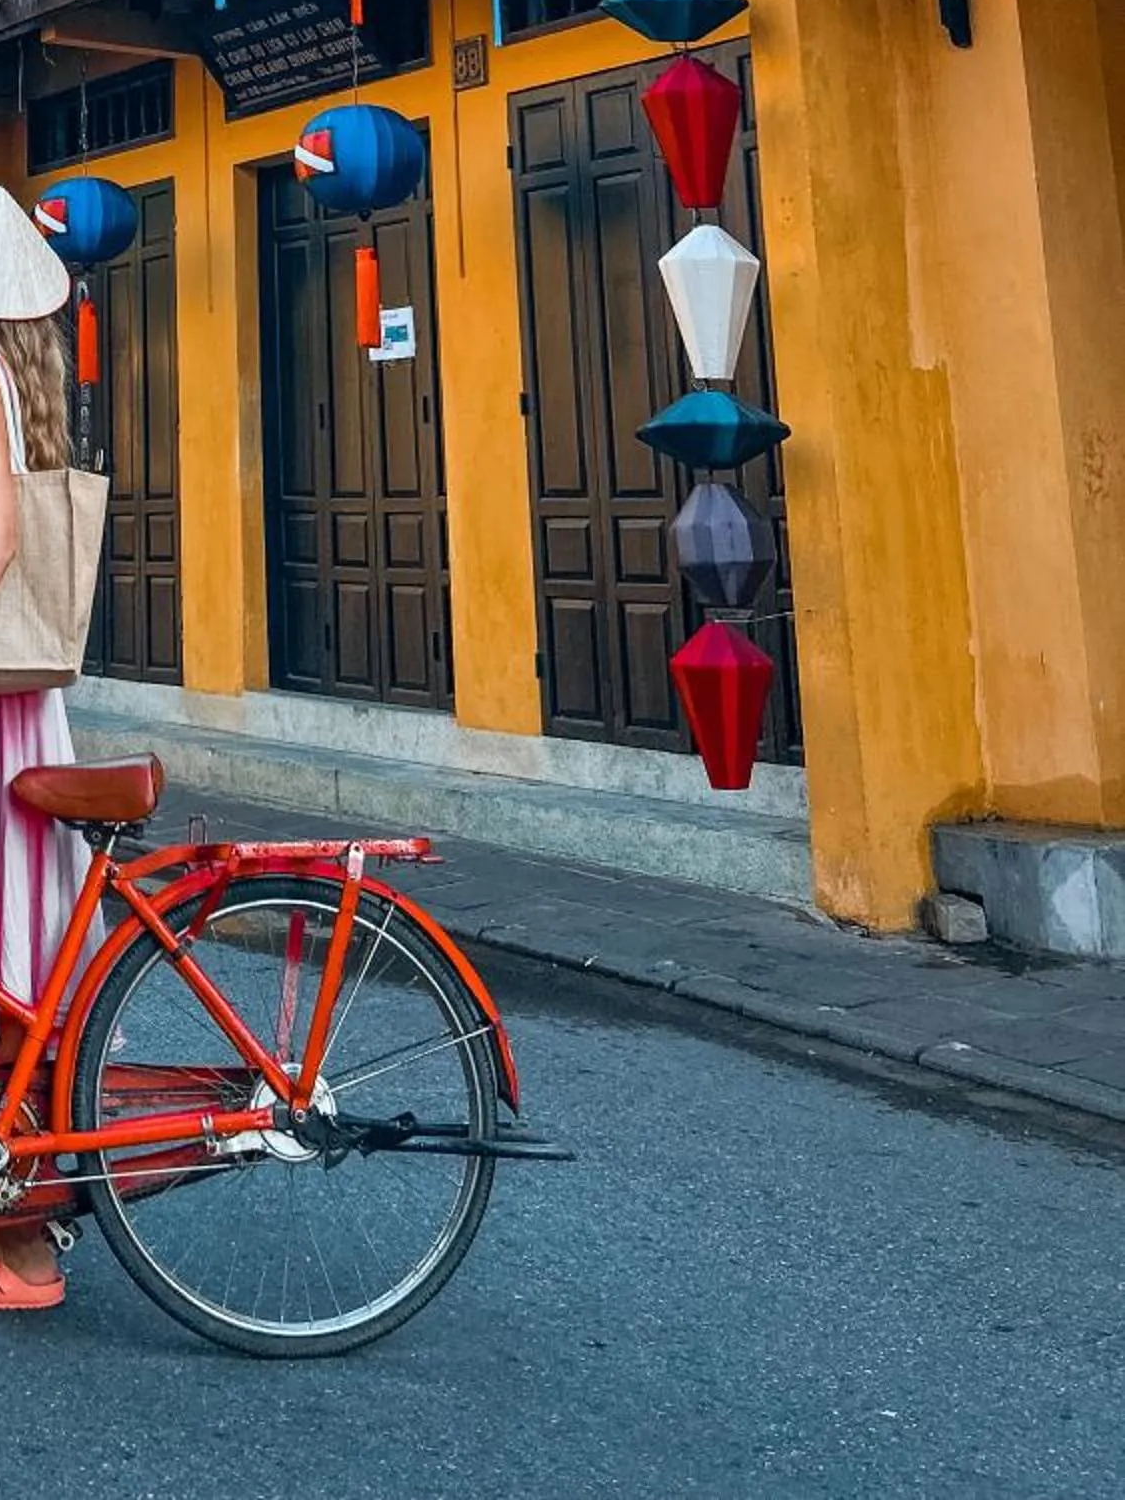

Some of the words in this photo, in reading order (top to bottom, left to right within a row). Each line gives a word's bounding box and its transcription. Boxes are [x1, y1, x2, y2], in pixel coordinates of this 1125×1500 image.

[252, 57, 289, 79] ISLAND
[287, 46, 324, 68] DIVING
[321, 35, 364, 58] CENTER
[456, 47, 479, 82] 88
